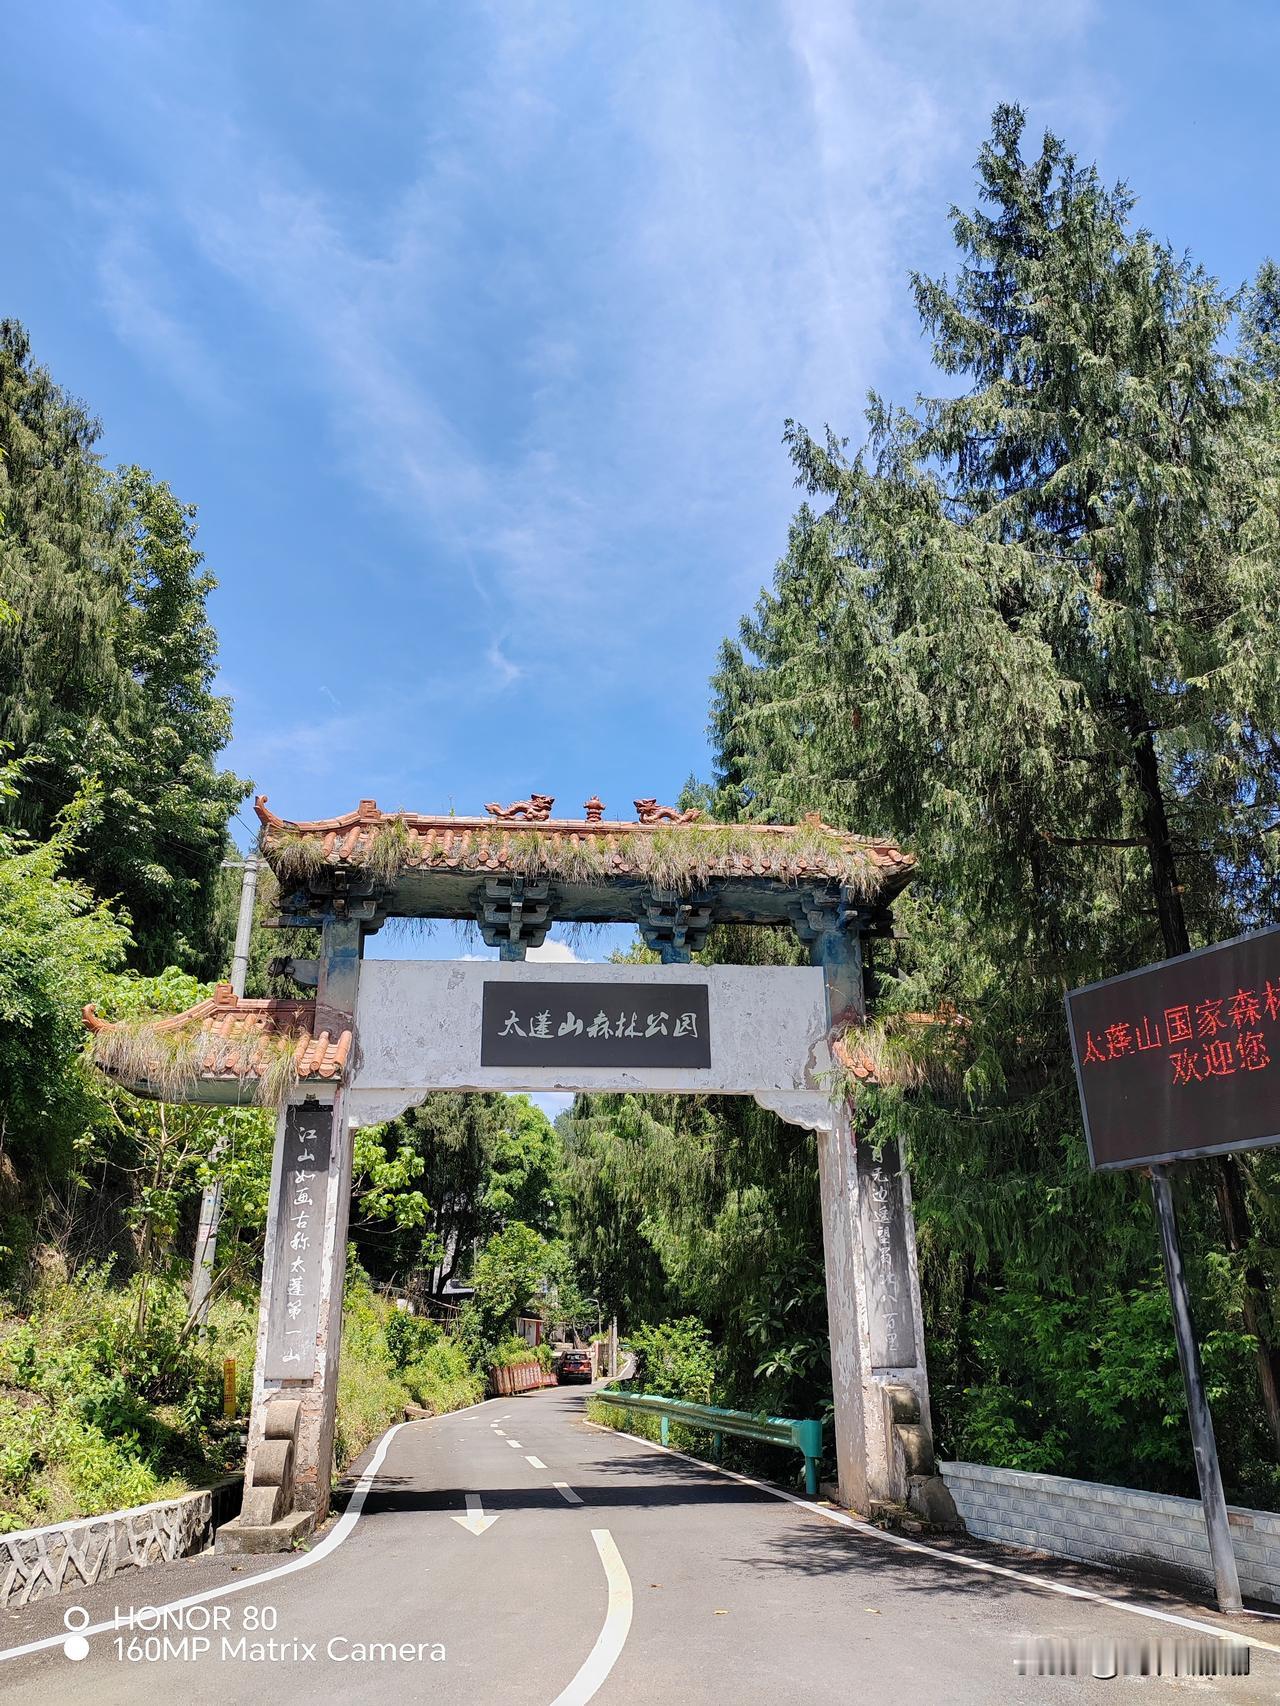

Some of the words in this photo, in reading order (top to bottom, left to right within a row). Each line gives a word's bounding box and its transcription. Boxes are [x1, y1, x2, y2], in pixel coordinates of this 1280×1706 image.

[497, 1009, 699, 1040] 太蓬山森林公园
[1168, 1030, 1271, 1086] 欢迎您
